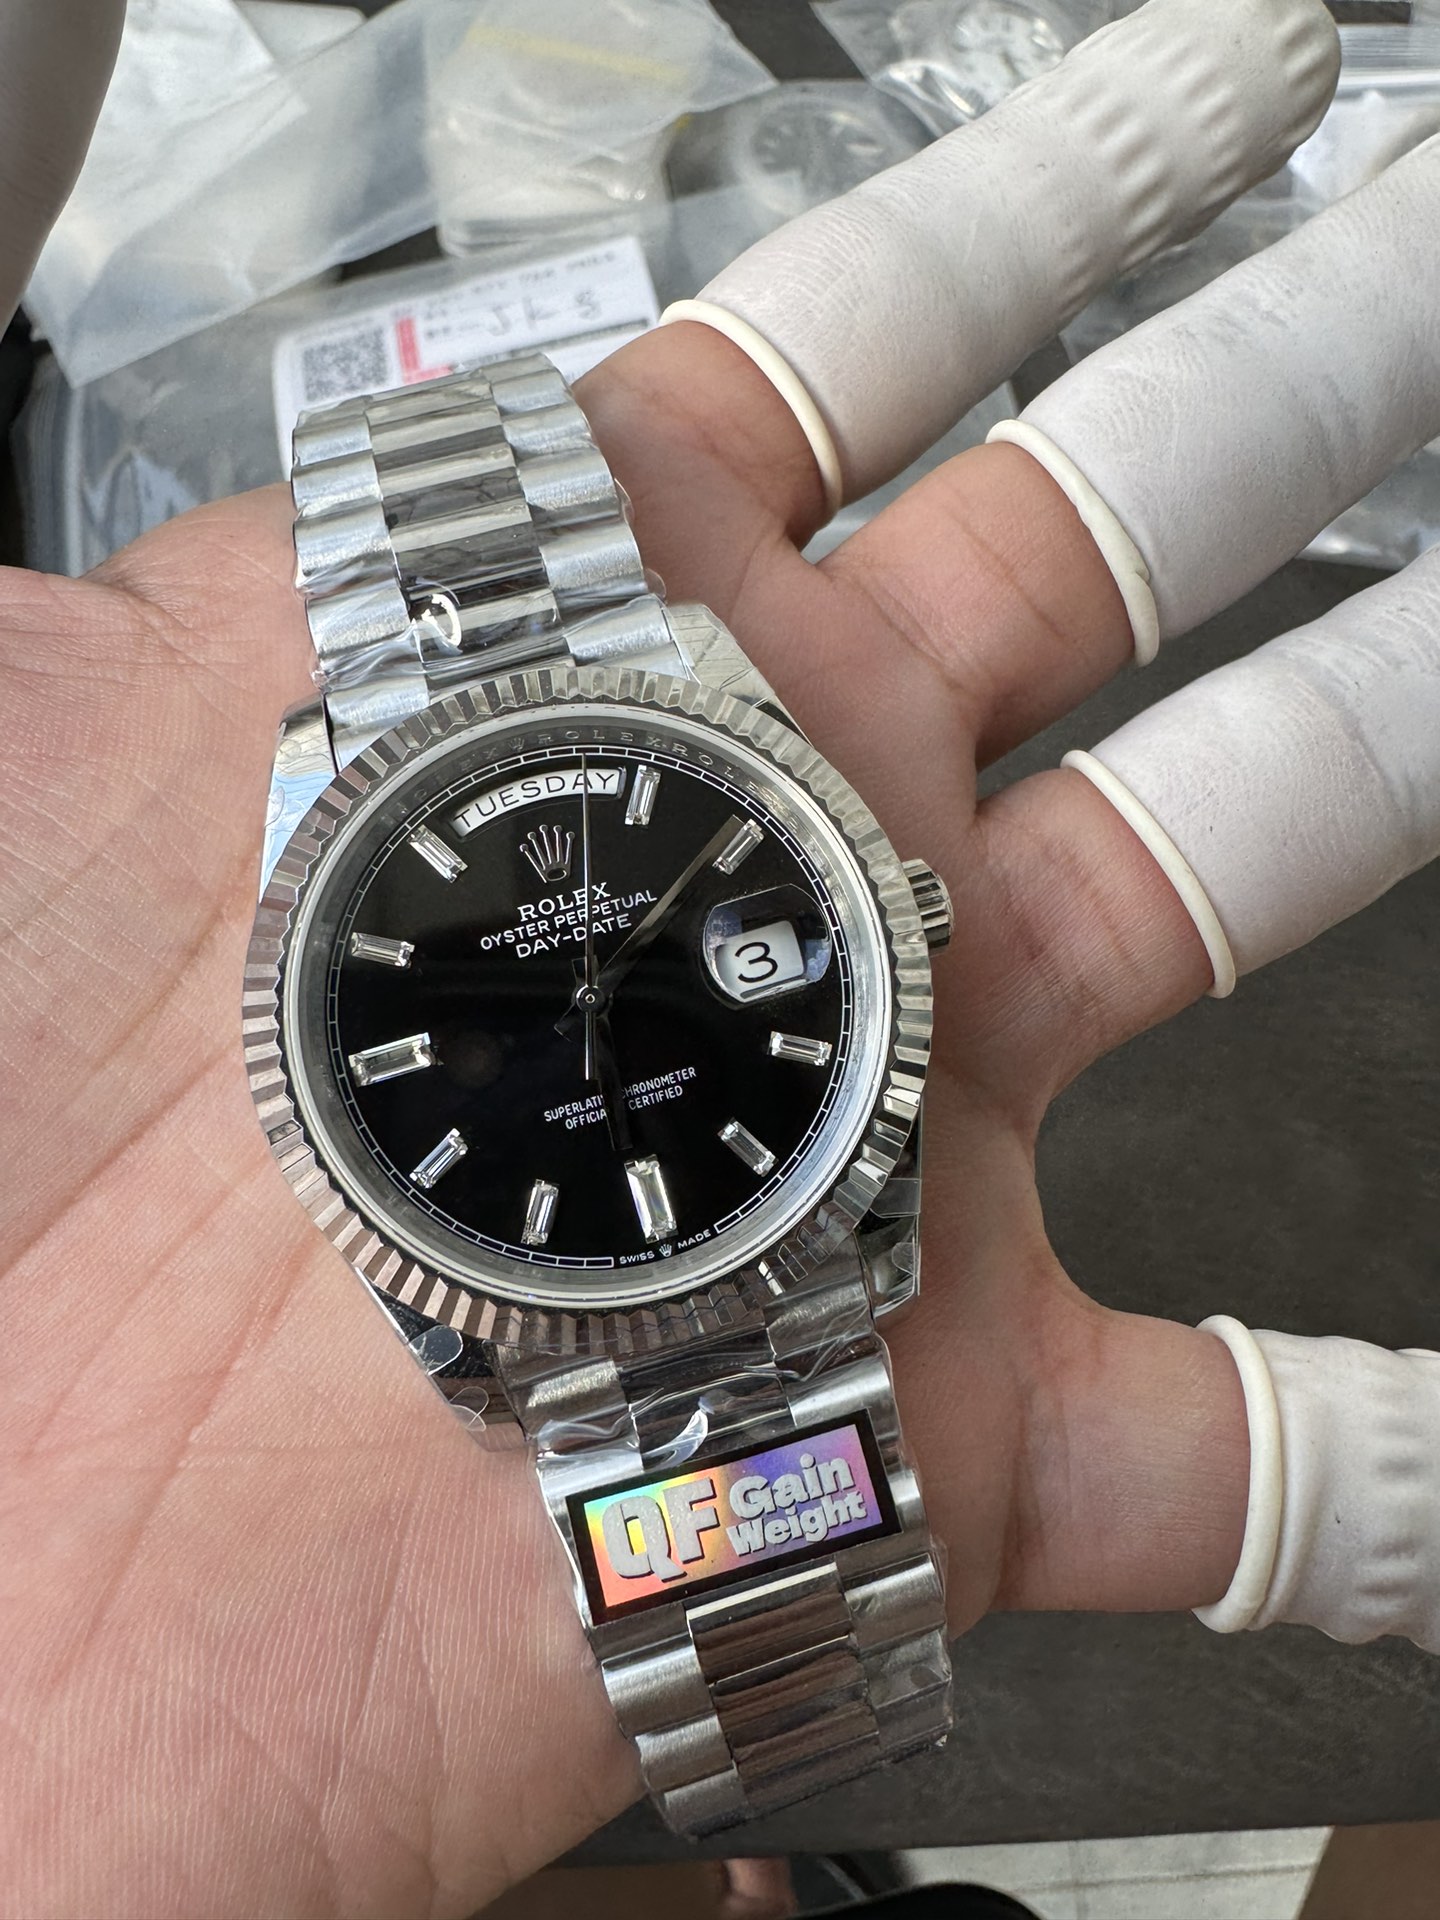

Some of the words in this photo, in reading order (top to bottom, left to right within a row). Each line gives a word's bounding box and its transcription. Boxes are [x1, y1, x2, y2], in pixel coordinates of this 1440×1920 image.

[453, 773, 615, 827] TUESDAY
[480, 919, 550, 950] OYSTER
[554, 890, 657, 928] PERPETUAL
[517, 882, 611, 922] ROLEX
[516, 914, 631, 958] DAY-DATE
[735, 942, 778, 983] 3
[544, 1094, 604, 1122] SUPERLATI
[565, 1108, 607, 1130] OFFICIA
[628, 1085, 683, 1110] CERTIFIED
[619, 1251, 655, 1264] SWISS
[677, 1229, 711, 1249] MADE
[602, 1477, 719, 1582] QF
[729, 1453, 855, 1520] Gain
[726, 1490, 867, 1557] Weight
